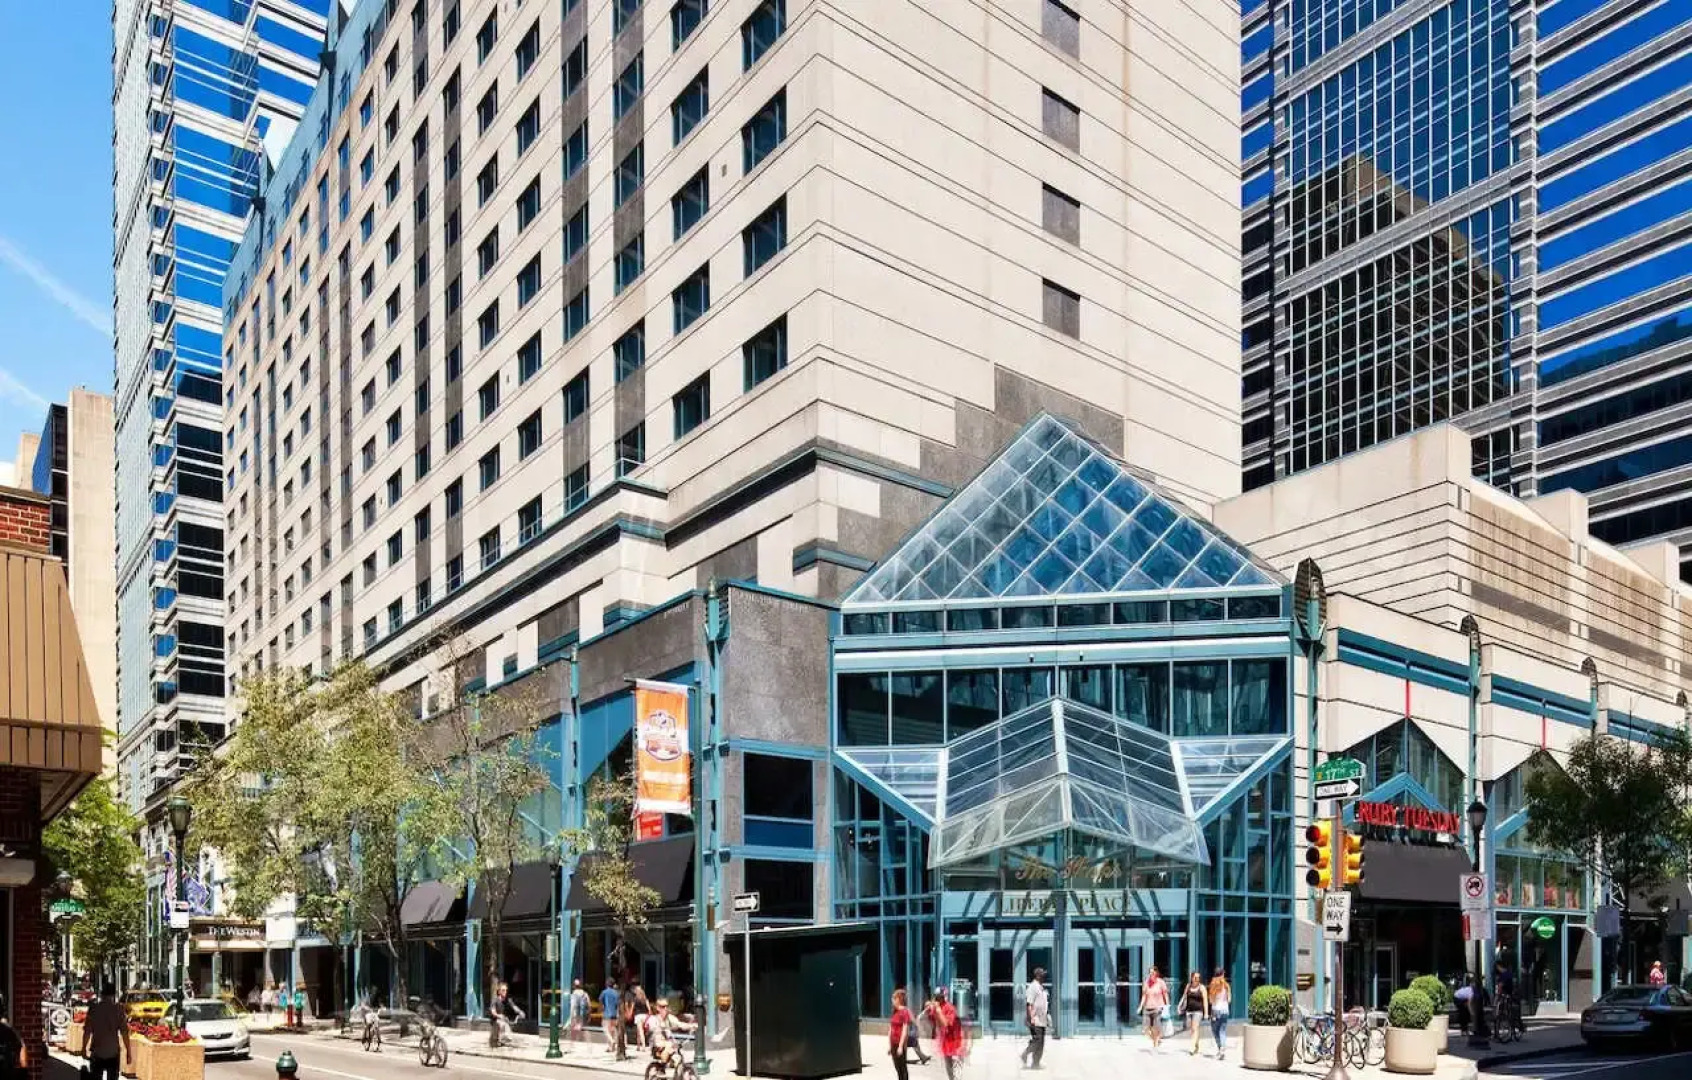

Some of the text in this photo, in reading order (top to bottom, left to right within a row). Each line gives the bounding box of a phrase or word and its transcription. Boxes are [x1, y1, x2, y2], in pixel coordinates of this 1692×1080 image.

[1358, 801, 1459, 835] RUBY TUESDAY
[1326, 896, 1345, 908] ONE
[1326, 909, 1345, 921] WAY
[208, 926, 260, 937] THE WESTIN
